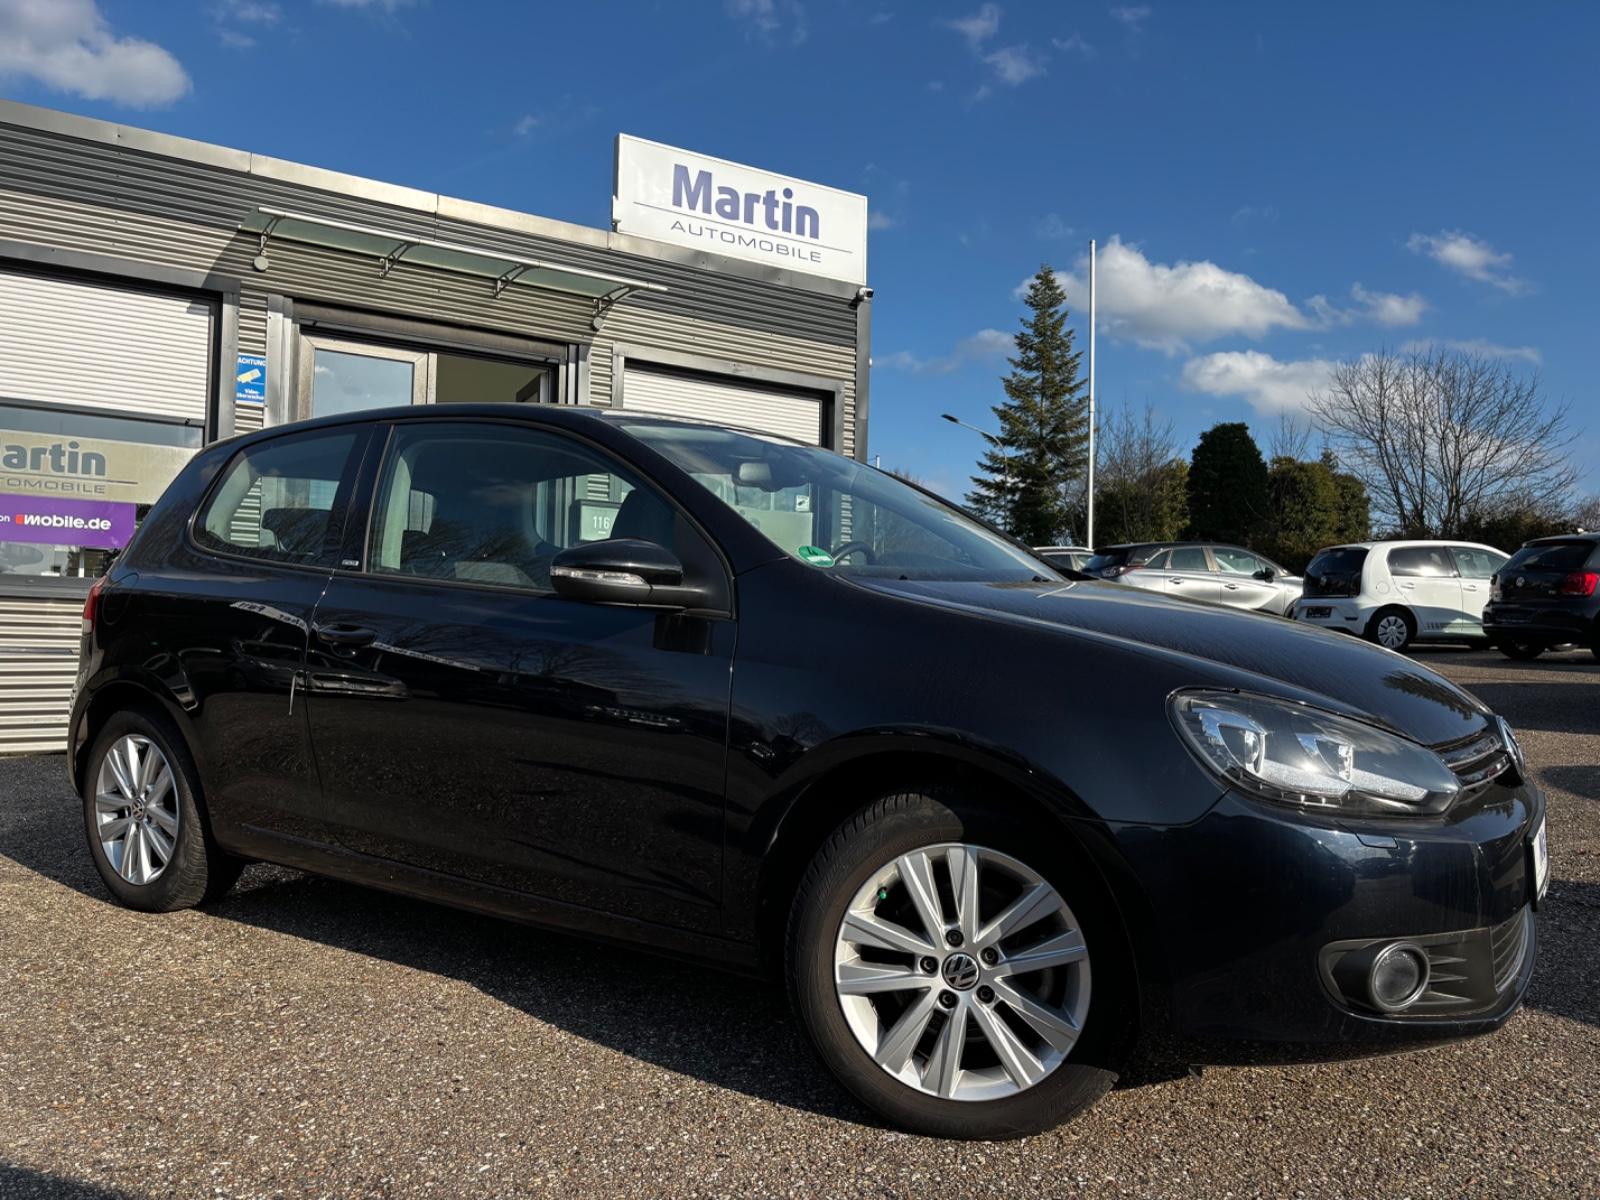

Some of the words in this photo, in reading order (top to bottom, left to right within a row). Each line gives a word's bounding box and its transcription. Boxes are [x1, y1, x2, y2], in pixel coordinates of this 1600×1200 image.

[672, 163, 819, 240] Martin
[671, 220, 822, 263] AUTOMOBILE
[24, 514, 112, 530] mobile.de
[593, 515, 610, 529] 116
